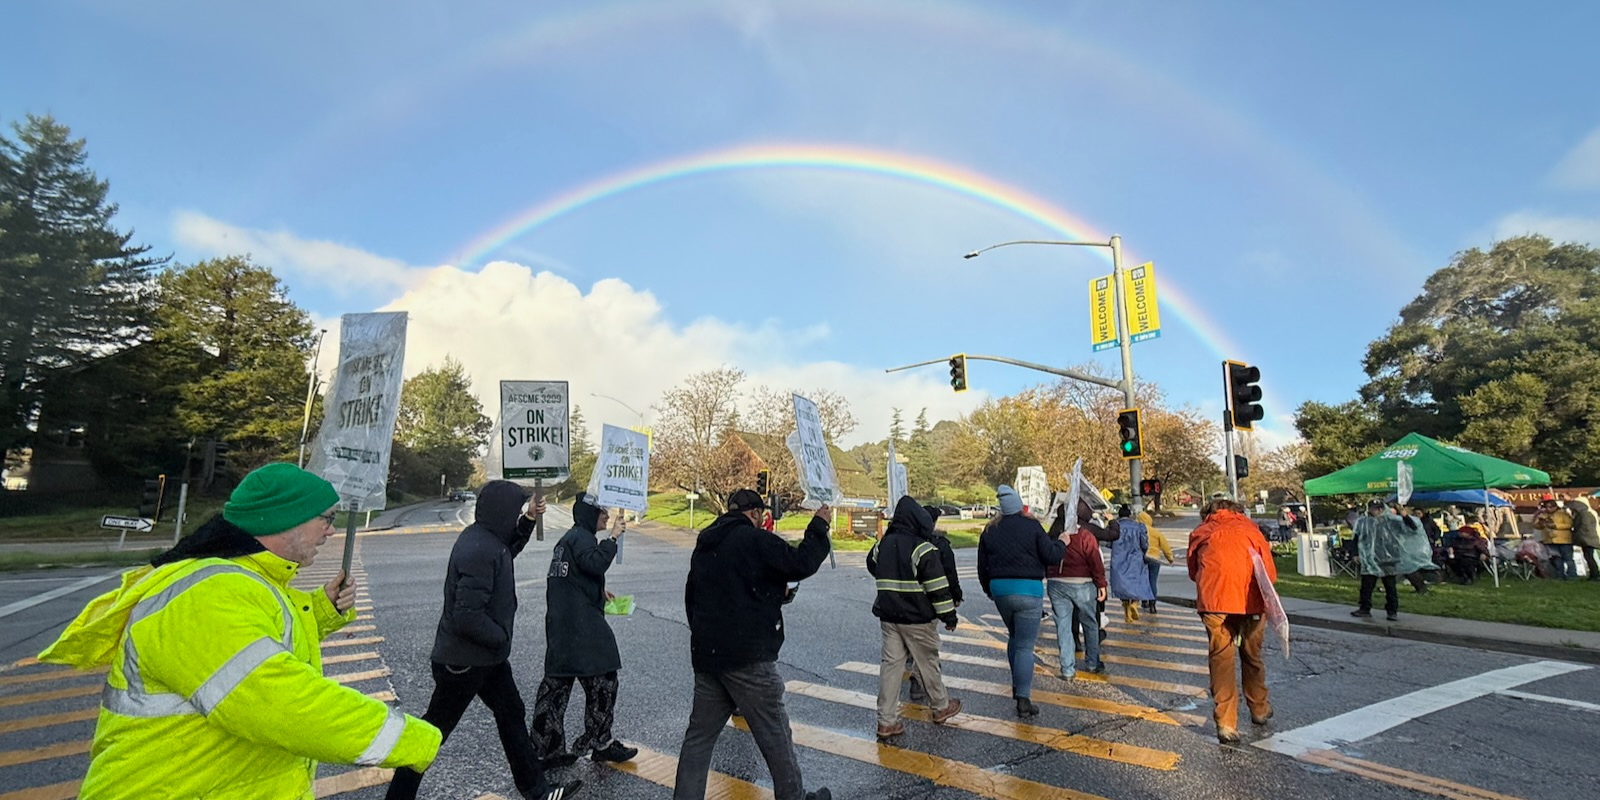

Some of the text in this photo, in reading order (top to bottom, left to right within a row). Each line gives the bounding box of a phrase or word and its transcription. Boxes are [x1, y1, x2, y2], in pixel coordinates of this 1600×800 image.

[1134, 280, 1149, 331] WELCOME
[1098, 291, 1108, 341] WELCOME
[508, 393, 540, 404] AFSCME
[526, 409, 544, 425] ON
[508, 426, 564, 448] STRIKE!
[1380, 449, 1419, 460] 3299
